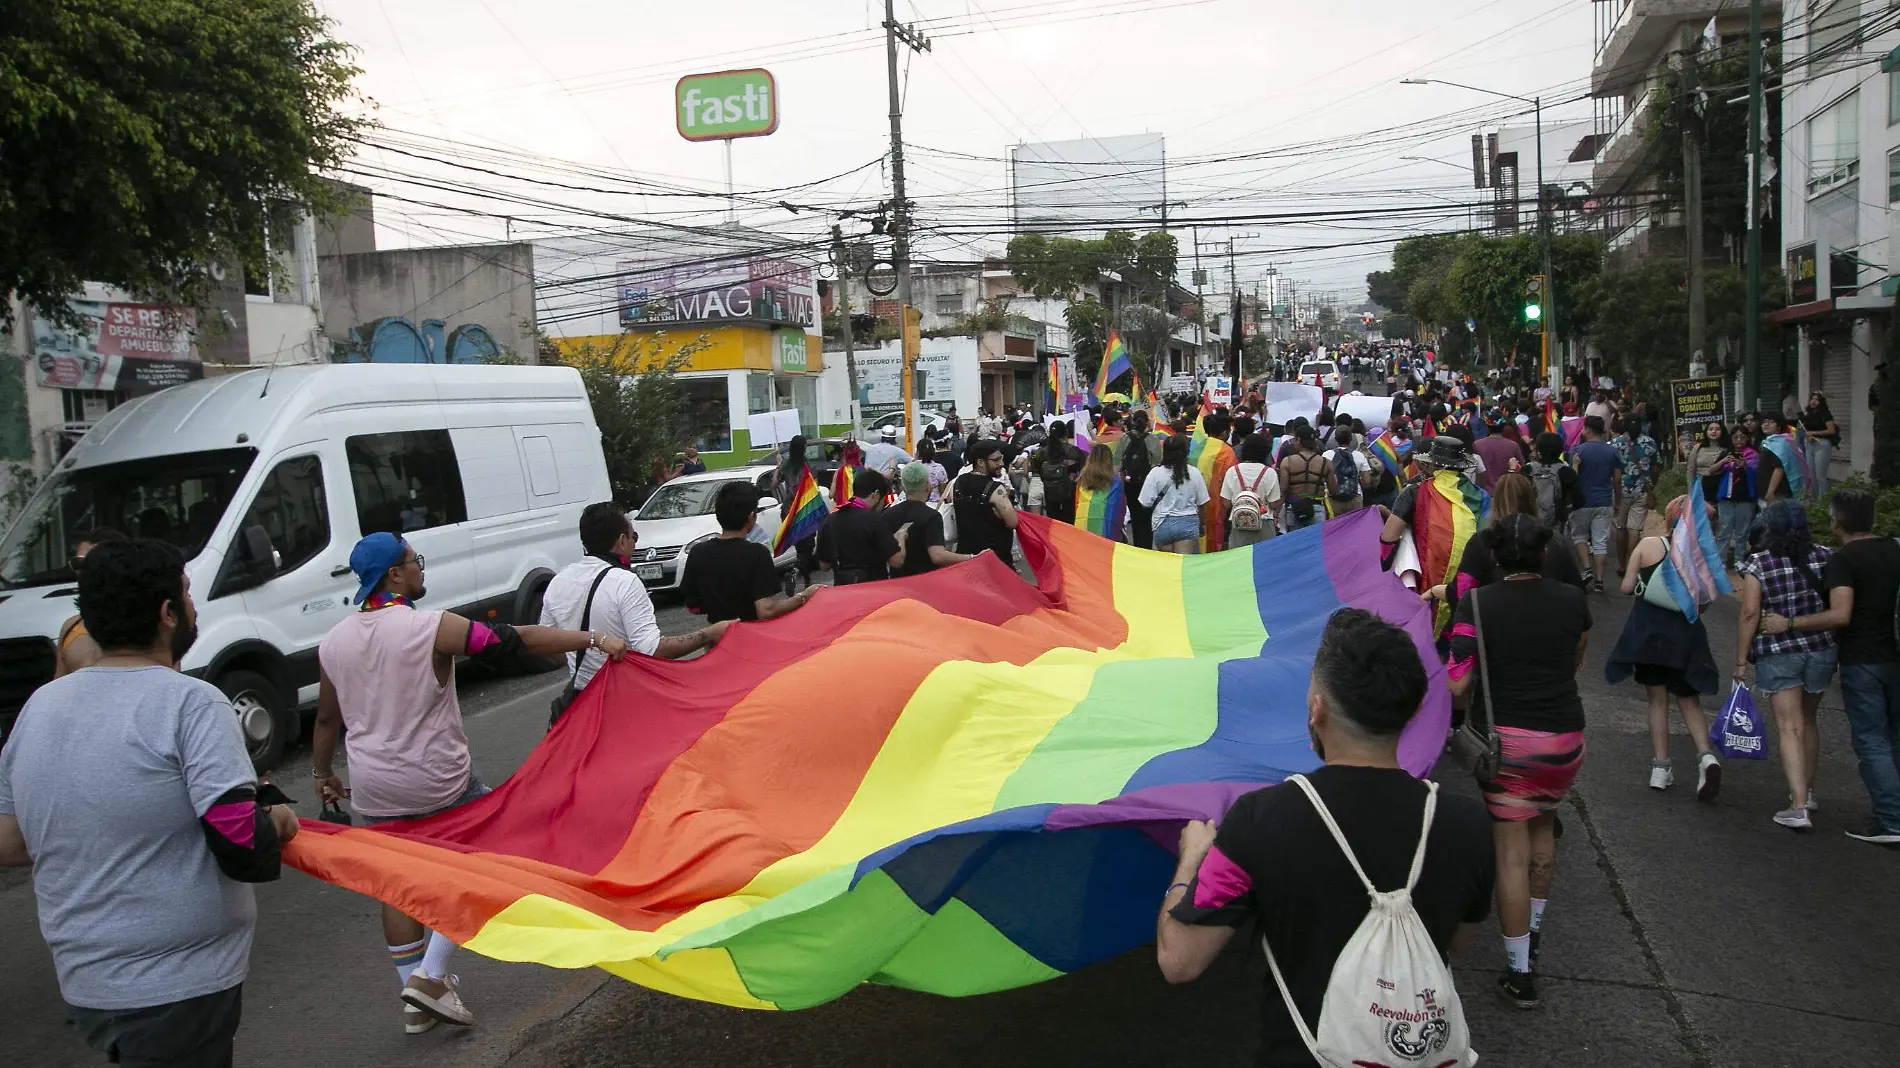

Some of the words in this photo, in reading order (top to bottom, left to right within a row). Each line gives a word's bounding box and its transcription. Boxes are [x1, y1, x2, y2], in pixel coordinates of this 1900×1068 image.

[682, 83, 769, 127] fasti
[111, 306, 134, 325] SE
[675, 286, 752, 321] MAG
[788, 294, 814, 325] MAG
[782, 336, 806, 365] fasti
[1678, 394, 1711, 404] SERVICIO
[1679, 402, 1716, 412] DOMICILIO
